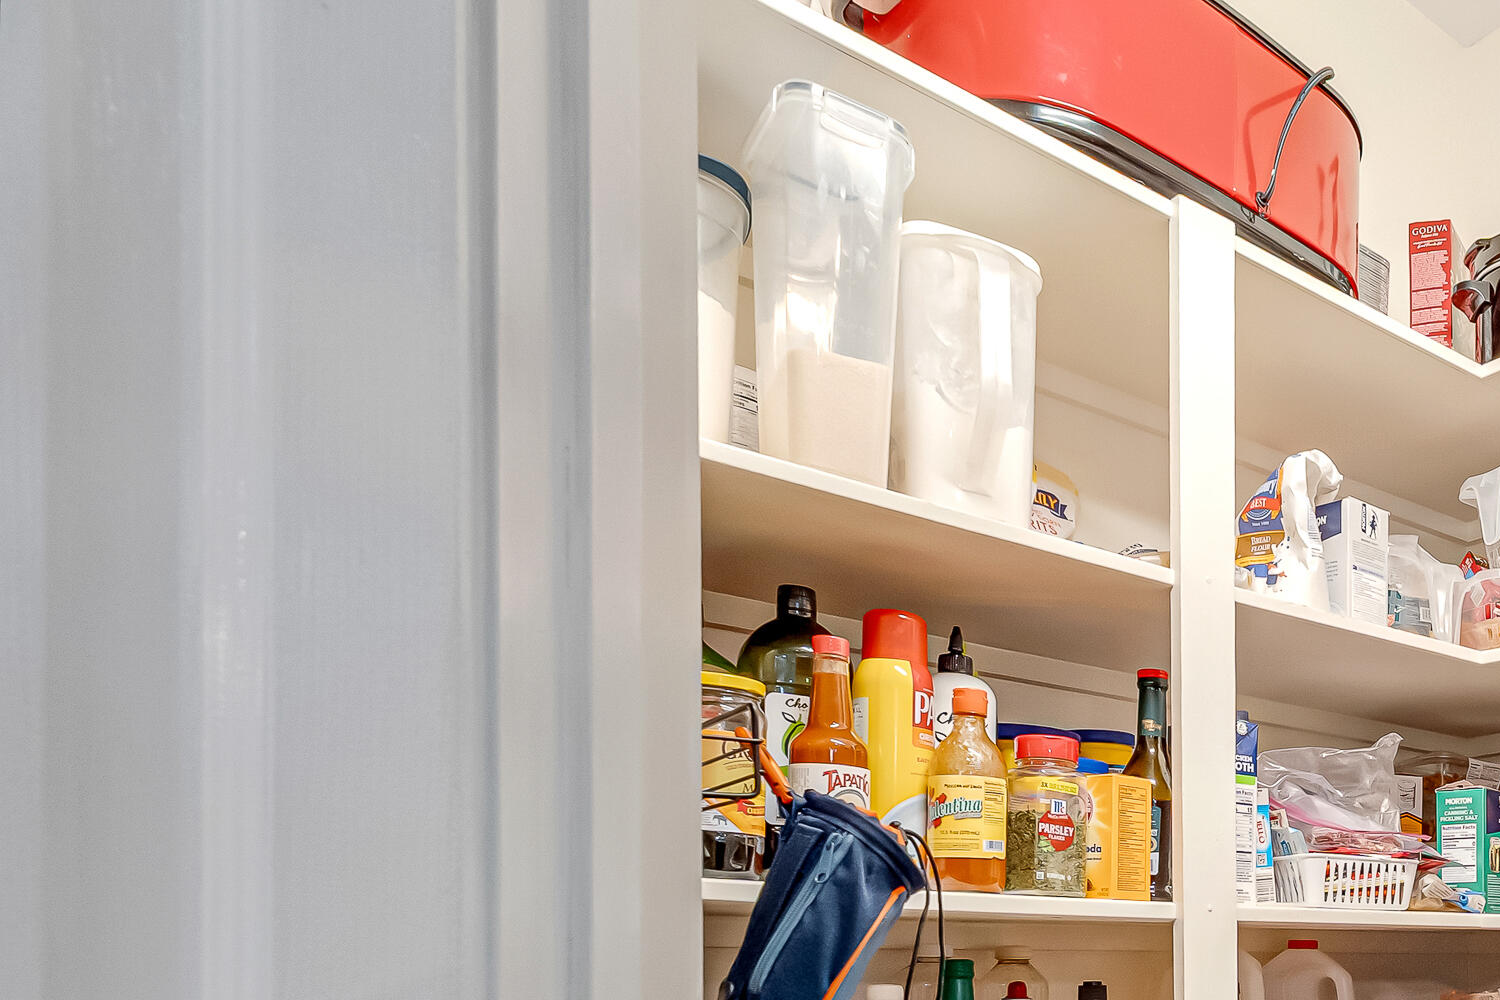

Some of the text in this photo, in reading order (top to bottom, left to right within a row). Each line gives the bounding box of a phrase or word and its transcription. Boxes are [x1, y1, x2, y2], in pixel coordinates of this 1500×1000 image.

[1411, 224, 1448, 236] GODIVA
[1250, 498, 1267, 509] BEST
[785, 697, 809, 710] Cho
[914, 690, 934, 726] PA
[1444, 797, 1473, 806] MORTON
[1038, 821, 1075, 838] PARSLEY
